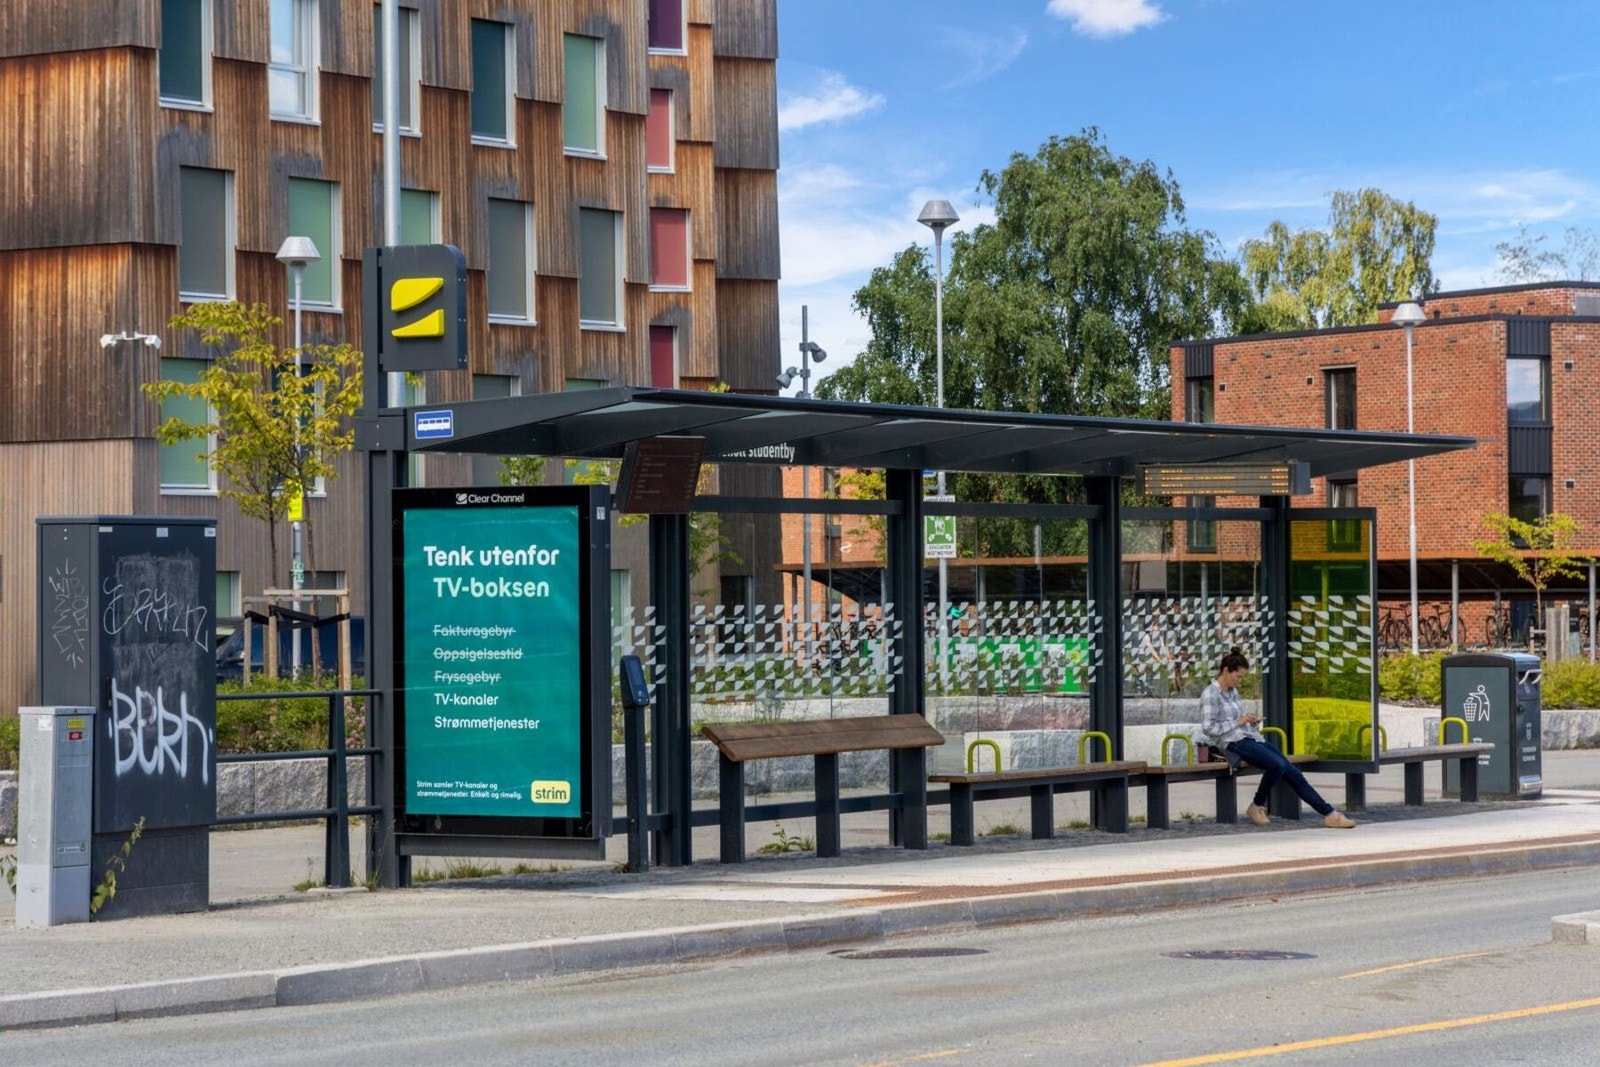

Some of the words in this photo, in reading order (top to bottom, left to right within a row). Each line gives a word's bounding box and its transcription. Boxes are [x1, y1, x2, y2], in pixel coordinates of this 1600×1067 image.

[468, 494, 489, 503] Clear
[491, 493, 525, 503] Channel
[423, 545, 474, 566] Tenk
[479, 544, 560, 566] utenfor
[433, 576, 549, 598] TV-boksen
[432, 624, 516, 639] Fakturagebyr
[433, 647, 524, 662] Oppsigelsestid
[433, 670, 501, 685] Frysegebyr
[434, 692, 499, 706] TV-kanaler
[434, 715, 540, 731] Strømmetjenester
[416, 780, 432, 788] Strim
[455, 781, 488, 789] TV-kanaler
[490, 783, 498, 791] og
[491, 792, 499, 800] og
[535, 788, 567, 800] strim
